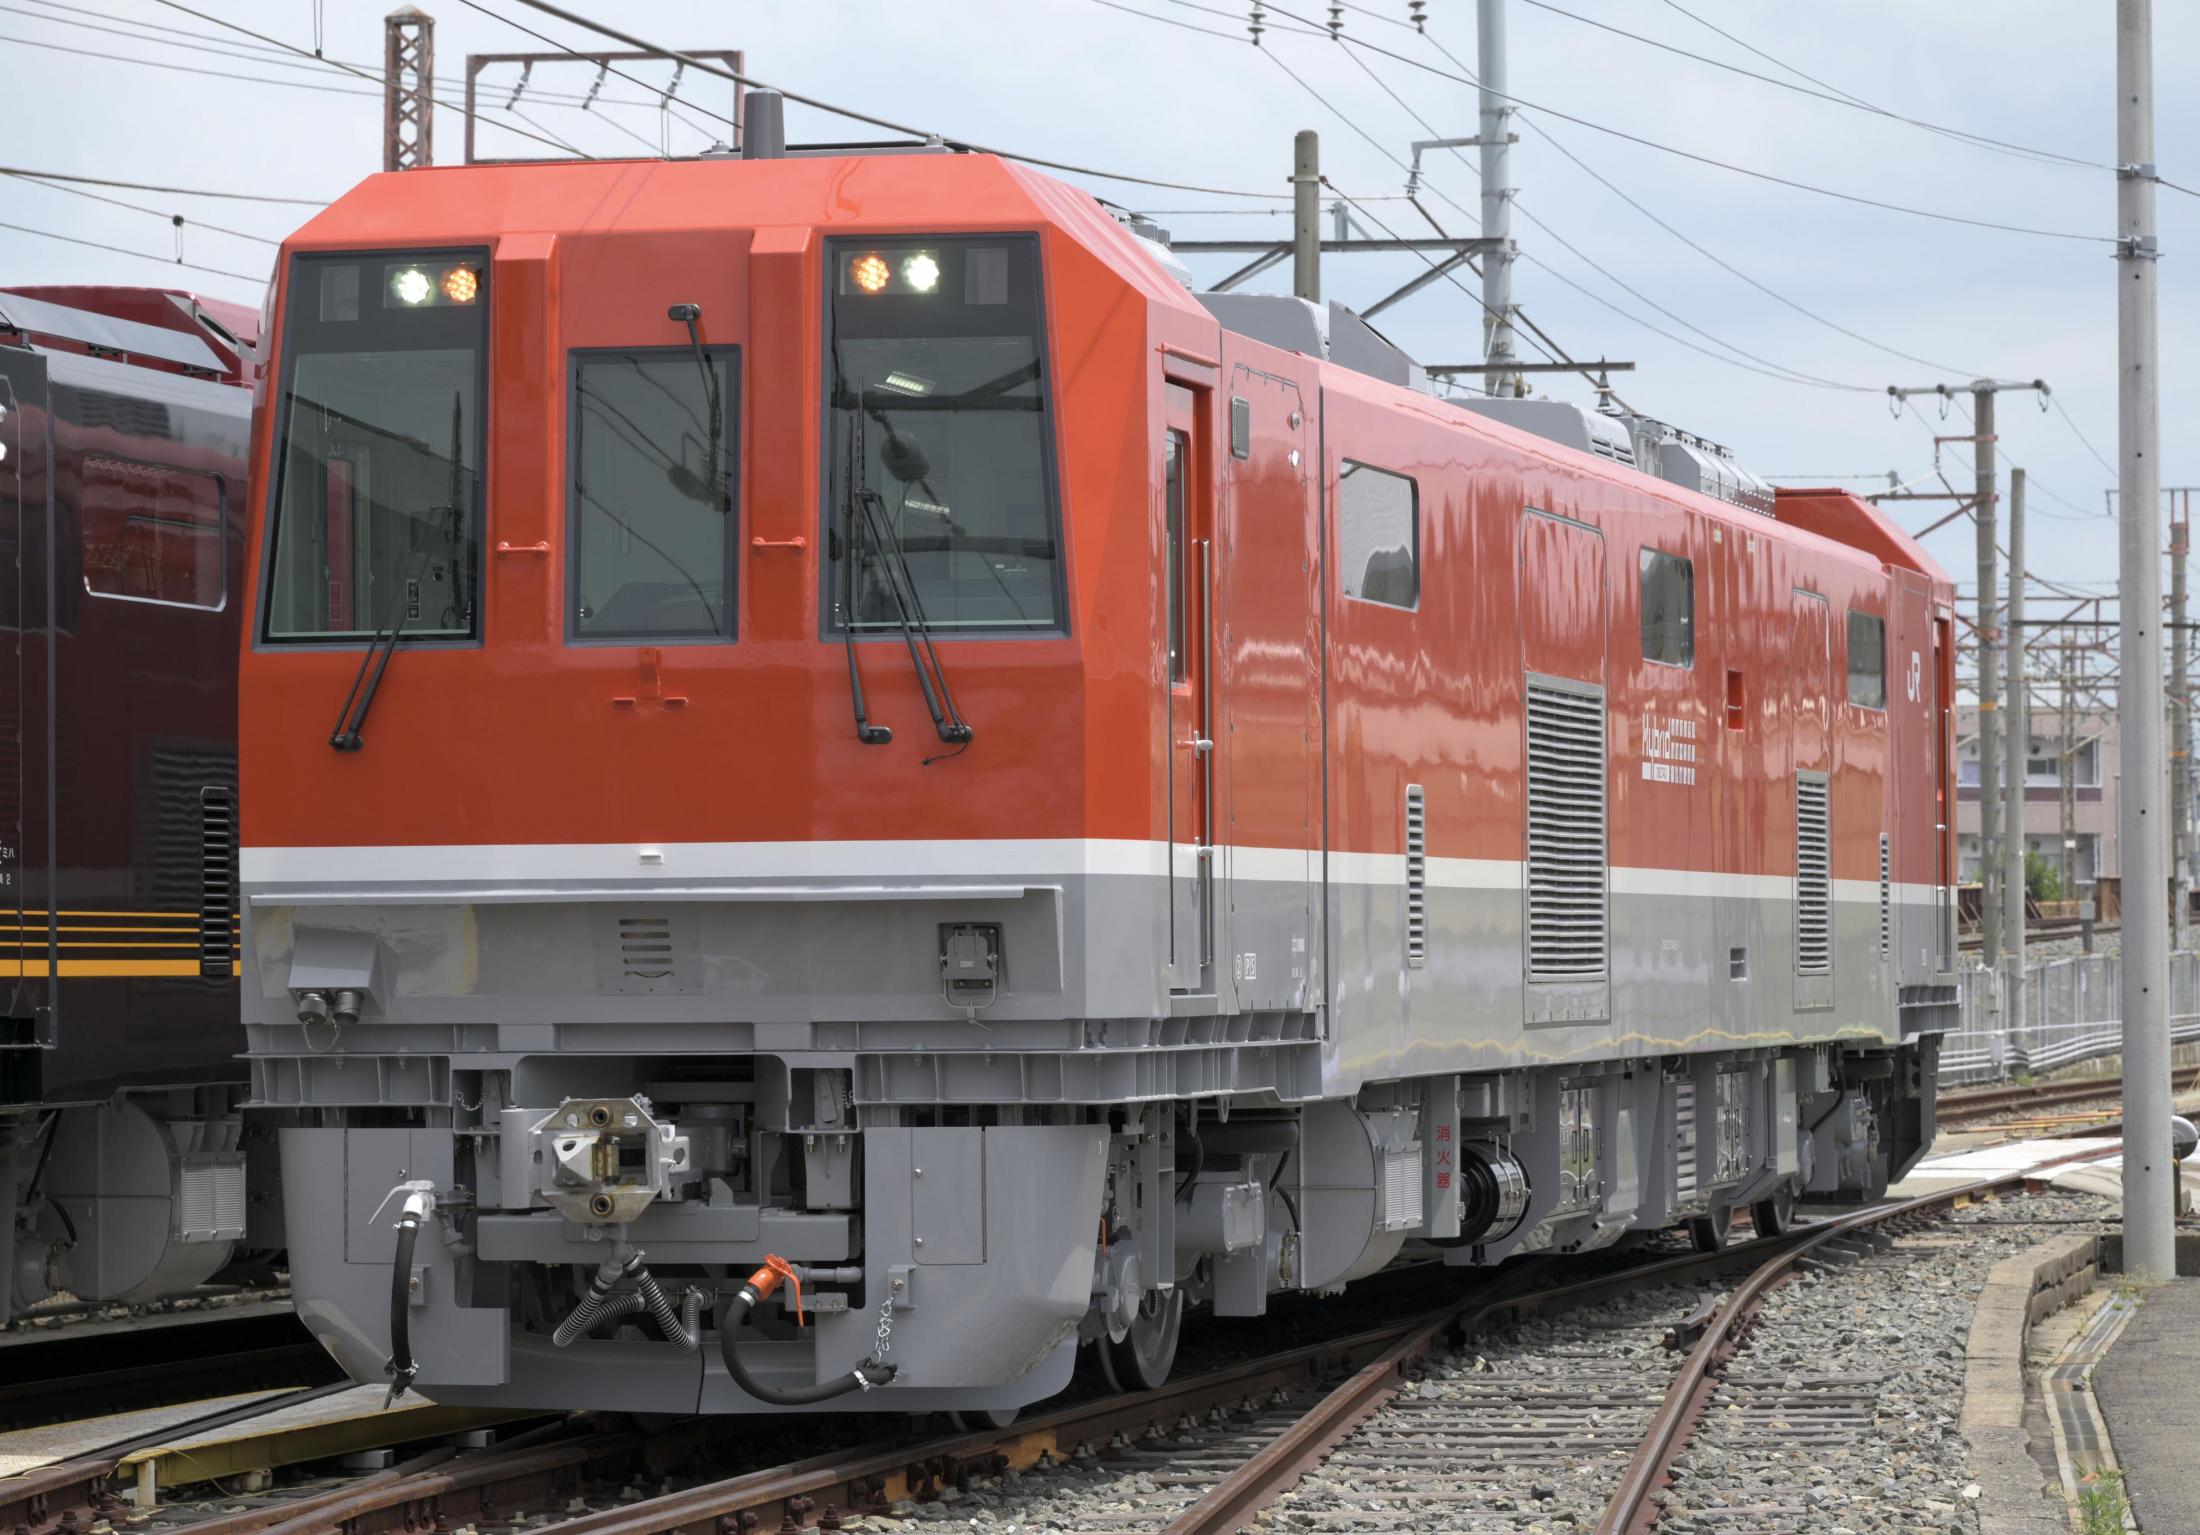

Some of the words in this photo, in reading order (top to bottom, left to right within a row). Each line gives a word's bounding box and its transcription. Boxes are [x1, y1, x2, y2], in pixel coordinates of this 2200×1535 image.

[1907, 650, 1921, 703] JR
[1642, 712, 1671, 780] Hybrid
[1436, 1125, 1451, 1190] 消火器
